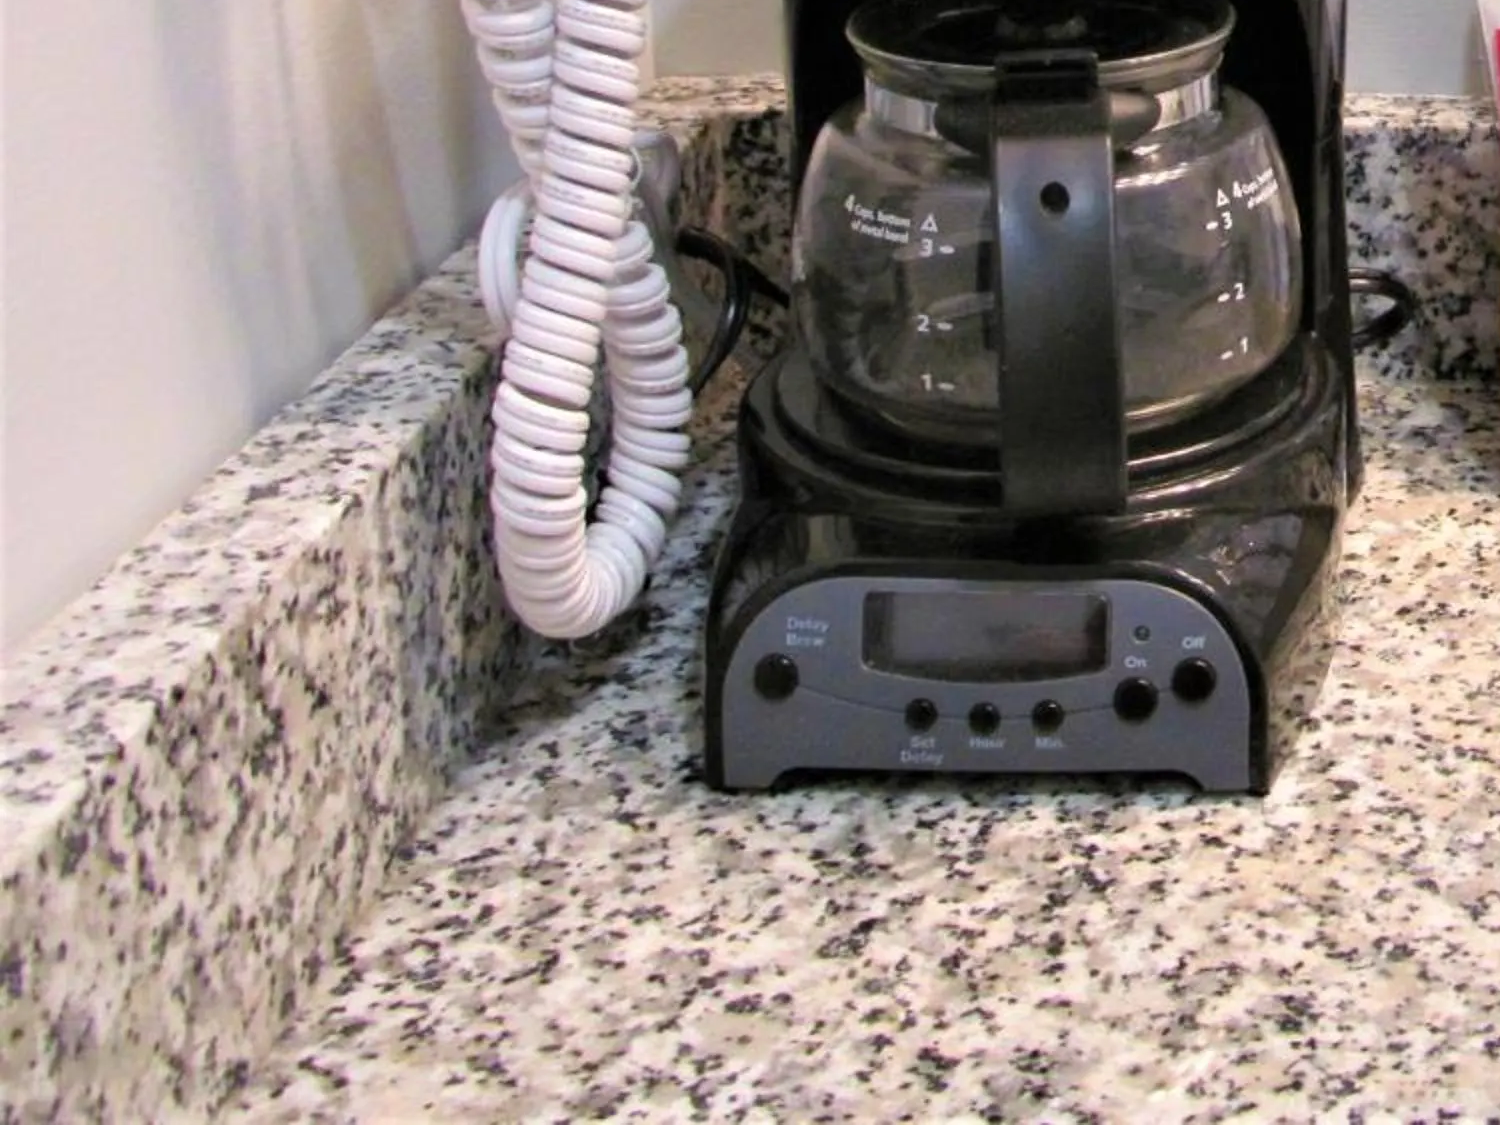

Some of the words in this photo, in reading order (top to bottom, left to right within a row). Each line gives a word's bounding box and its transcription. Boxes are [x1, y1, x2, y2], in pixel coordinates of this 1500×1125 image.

[1221, 211, 1233, 230] 3
[920, 238, 934, 257] 3
[1234, 282, 1245, 300] 2
[917, 314, 930, 332] 2
[1241, 336, 1249, 353] 1
[921, 374, 932, 391] 1
[1124, 656, 1147, 668] On
